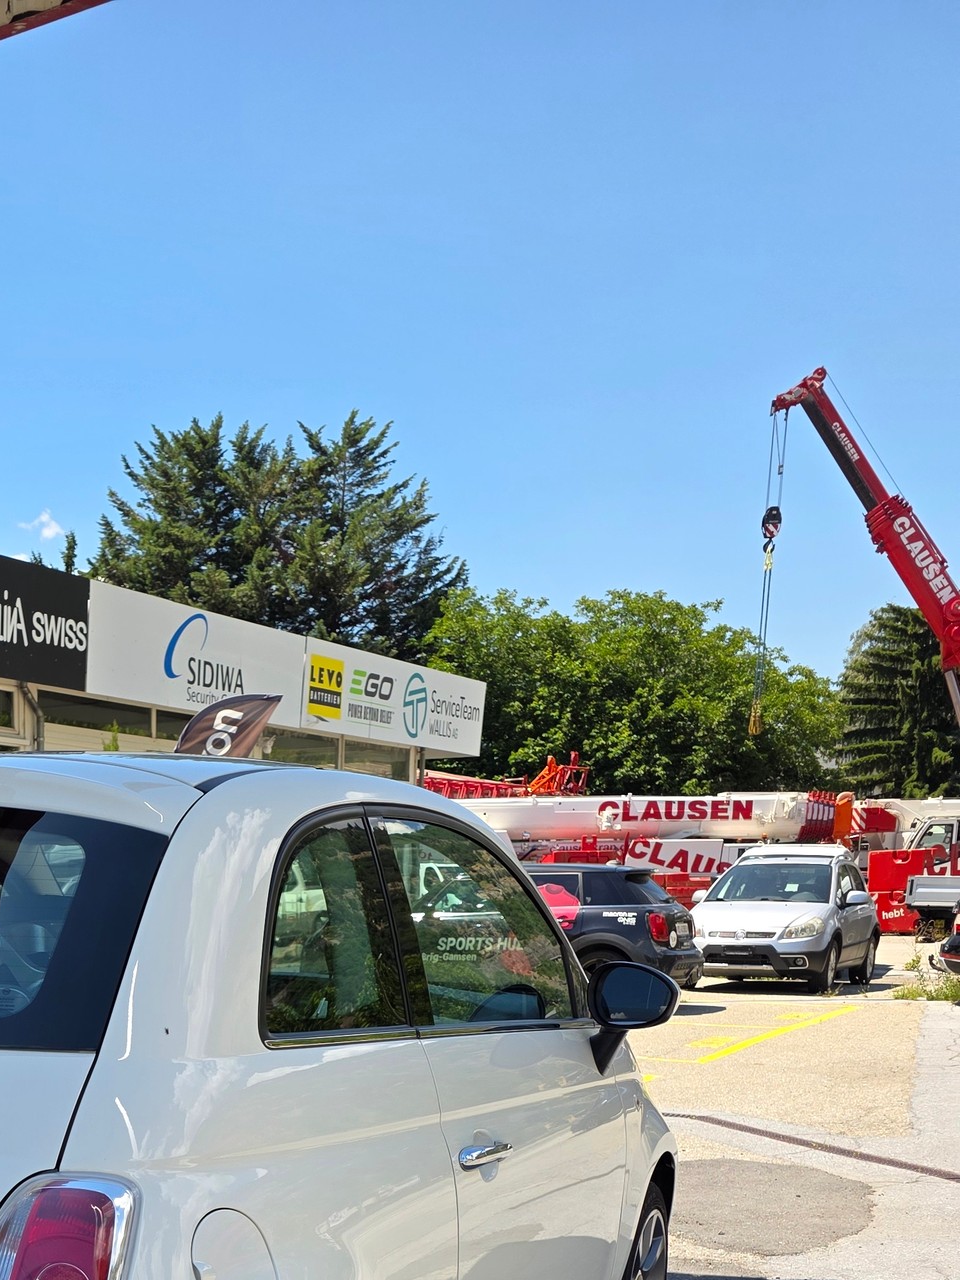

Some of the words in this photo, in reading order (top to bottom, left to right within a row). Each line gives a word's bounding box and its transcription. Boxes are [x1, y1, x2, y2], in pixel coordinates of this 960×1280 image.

[832, 421, 860, 462] CLAUSEN
[893, 516, 957, 605] CLAUSEN
[32, 611, 87, 652] SWISS
[187, 656, 244, 694] SIDIWA
[310, 665, 343, 688] LEVO
[349, 669, 394, 700] EGO
[430, 690, 480, 721] ServiceTeam
[429, 719, 452, 738] WALLIS
[598, 799, 754, 822] CLAUSEN
[882, 908, 905, 920] hebt
[437, 937, 494, 951] SPORTS
[422, 952, 477, 964] Brig-Gamsen
